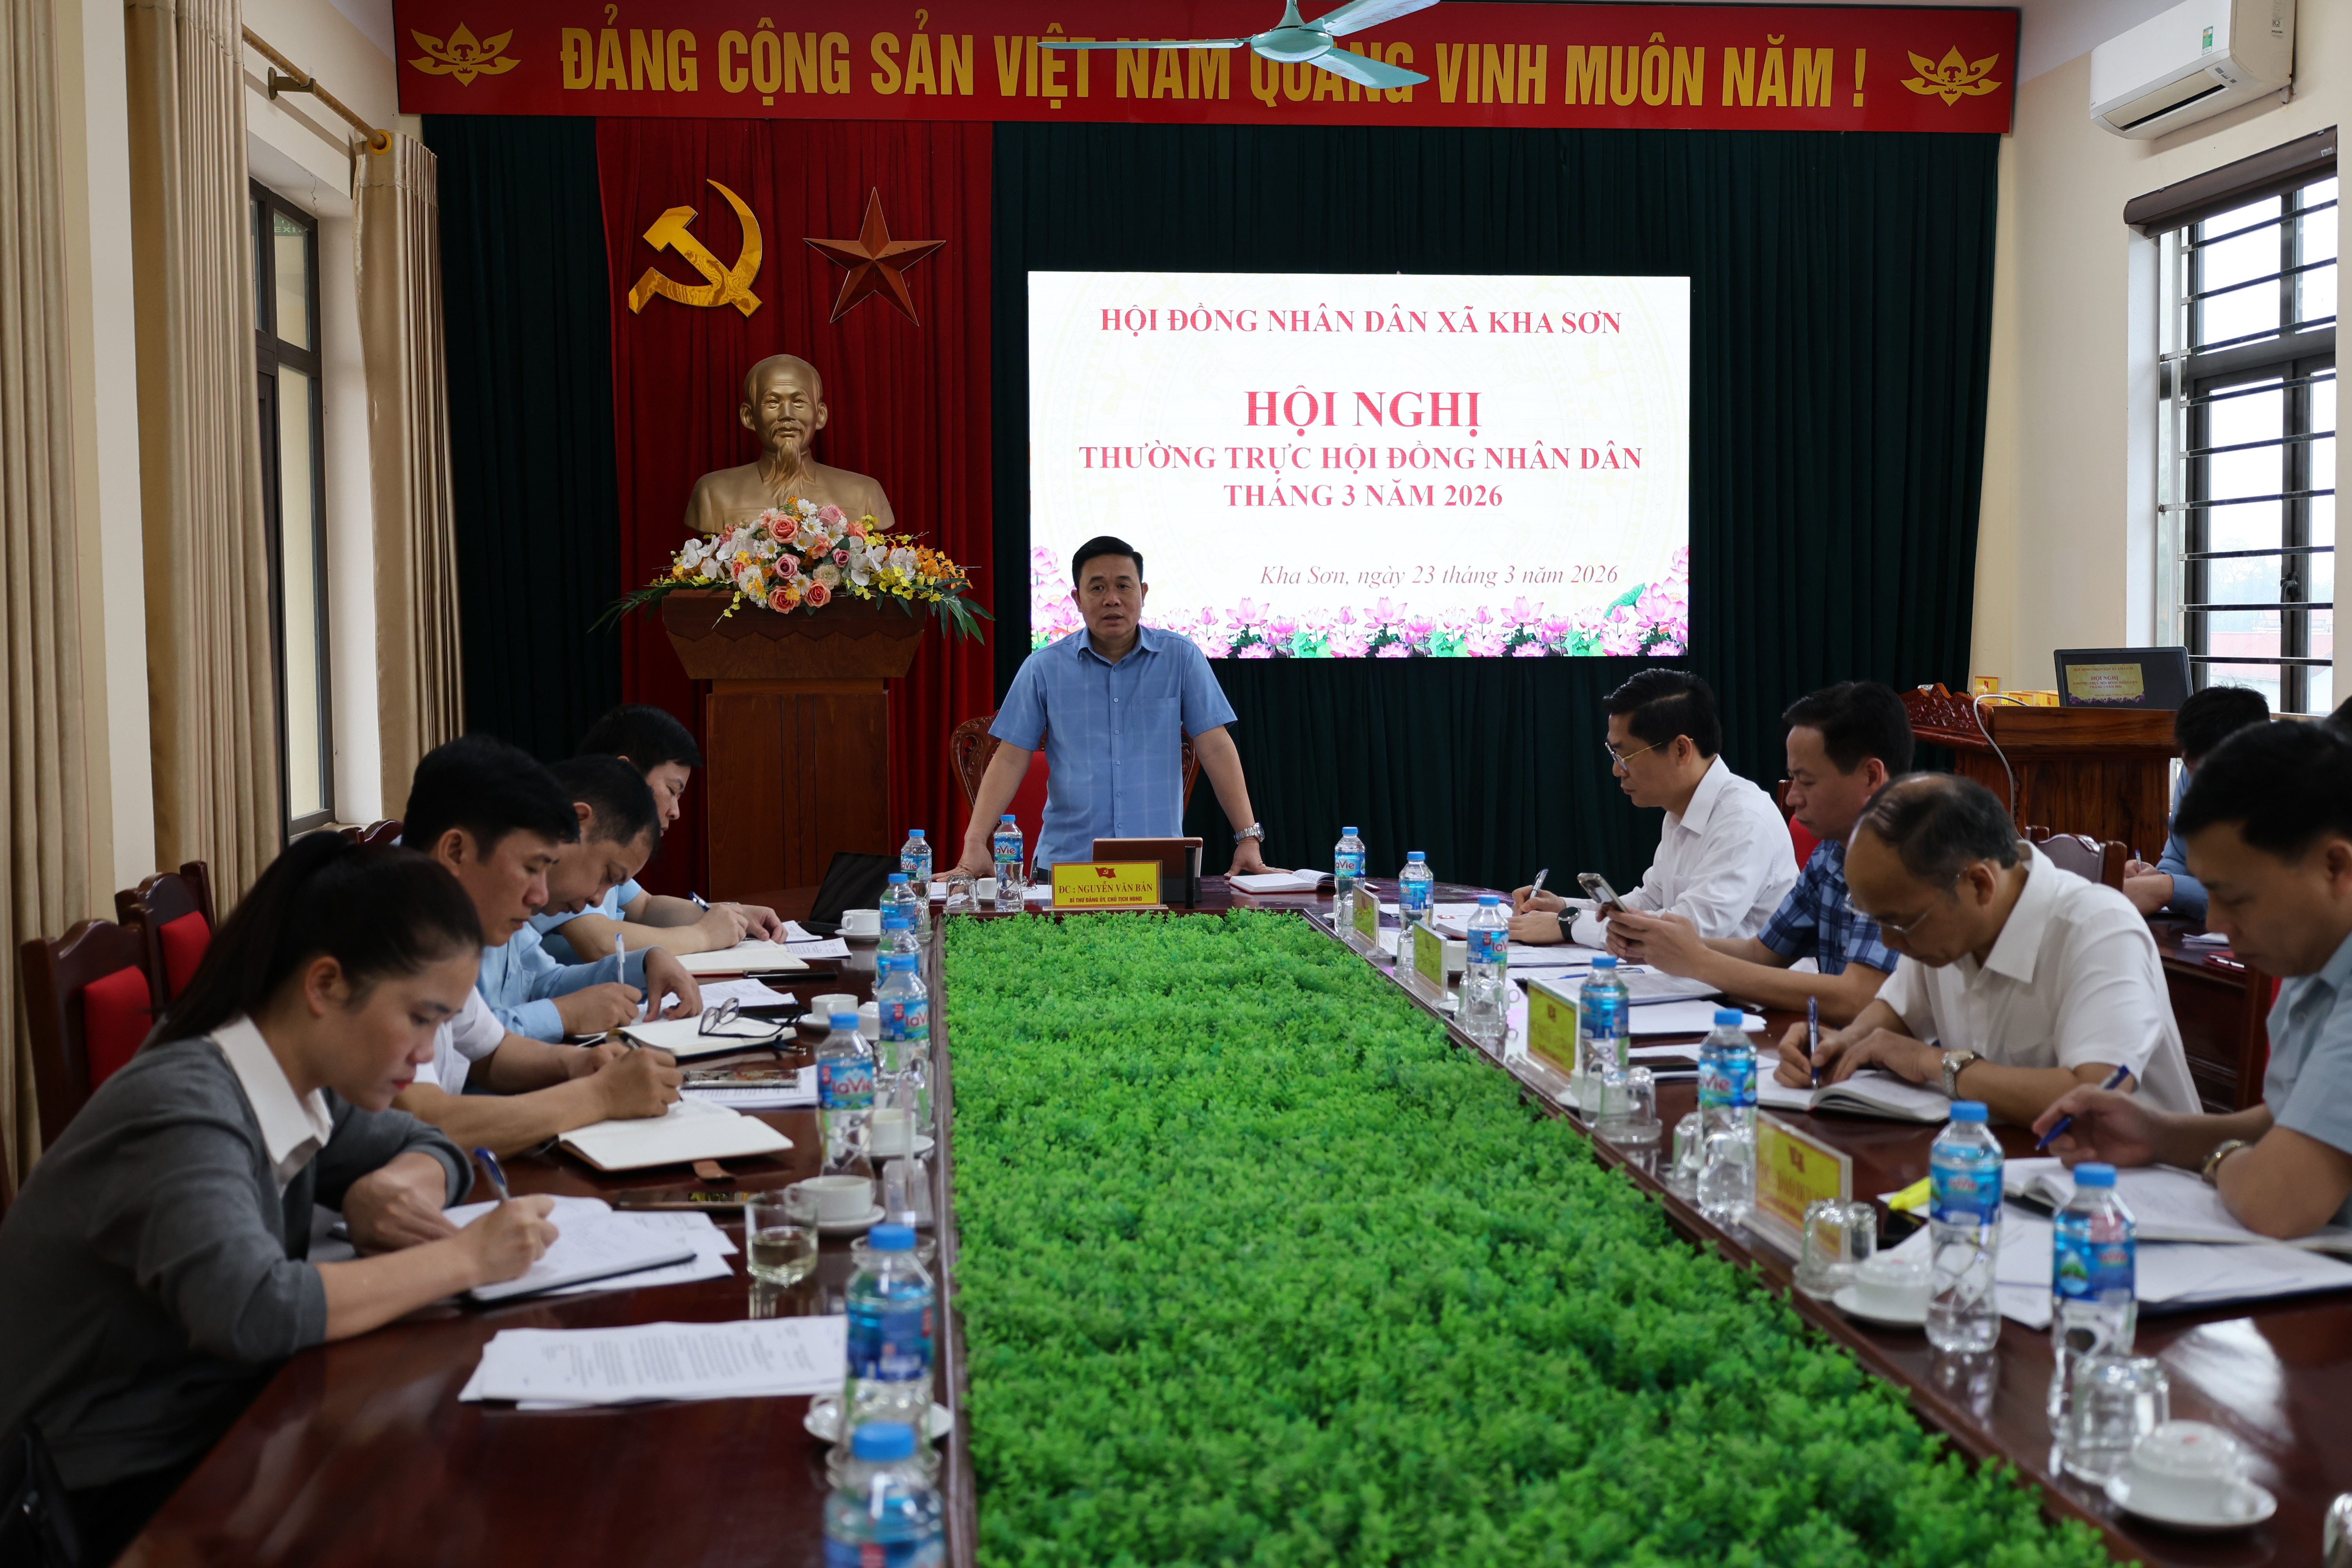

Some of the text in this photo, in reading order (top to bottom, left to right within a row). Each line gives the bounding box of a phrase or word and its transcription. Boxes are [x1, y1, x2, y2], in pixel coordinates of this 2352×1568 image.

[561, 4, 698, 92] ĐẢNG
[719, 17, 850, 106] CỘNG
[870, 9, 973, 96] SẢN
[994, 23, 1096, 109] VIỆT
[1116, 38, 1230, 100] NAM
[1436, 43, 1547, 104] VINH
[1565, 32, 1705, 106] MUÔN
[1722, 34, 1833, 107] NĂM
[1853, 48, 1866, 107] !
[1102, 302, 1620, 337] HỘI ĐỒNG NHÂN DÂN XÃ KHA SƠN
[1245, 385, 1481, 437] HỘI NGHỊ
[1079, 439, 1641, 476] THƯỜNG TRỰC HỘI ĐỒNG NHÂN DÂN
[1224, 478, 1503, 506] THÁNG 3 NĂM 2026
[1261, 565, 1618, 589] Kha Sơn, ngày 23 tháng 3 năm 2026
[1336, 860, 1355, 869] aVie
[1058, 885, 1071, 893] ĐC
[1078, 881, 1113, 893] NGUYỄN
[1116, 882, 1133, 892] VĂN
[1135, 881, 1152, 891] BẢN
